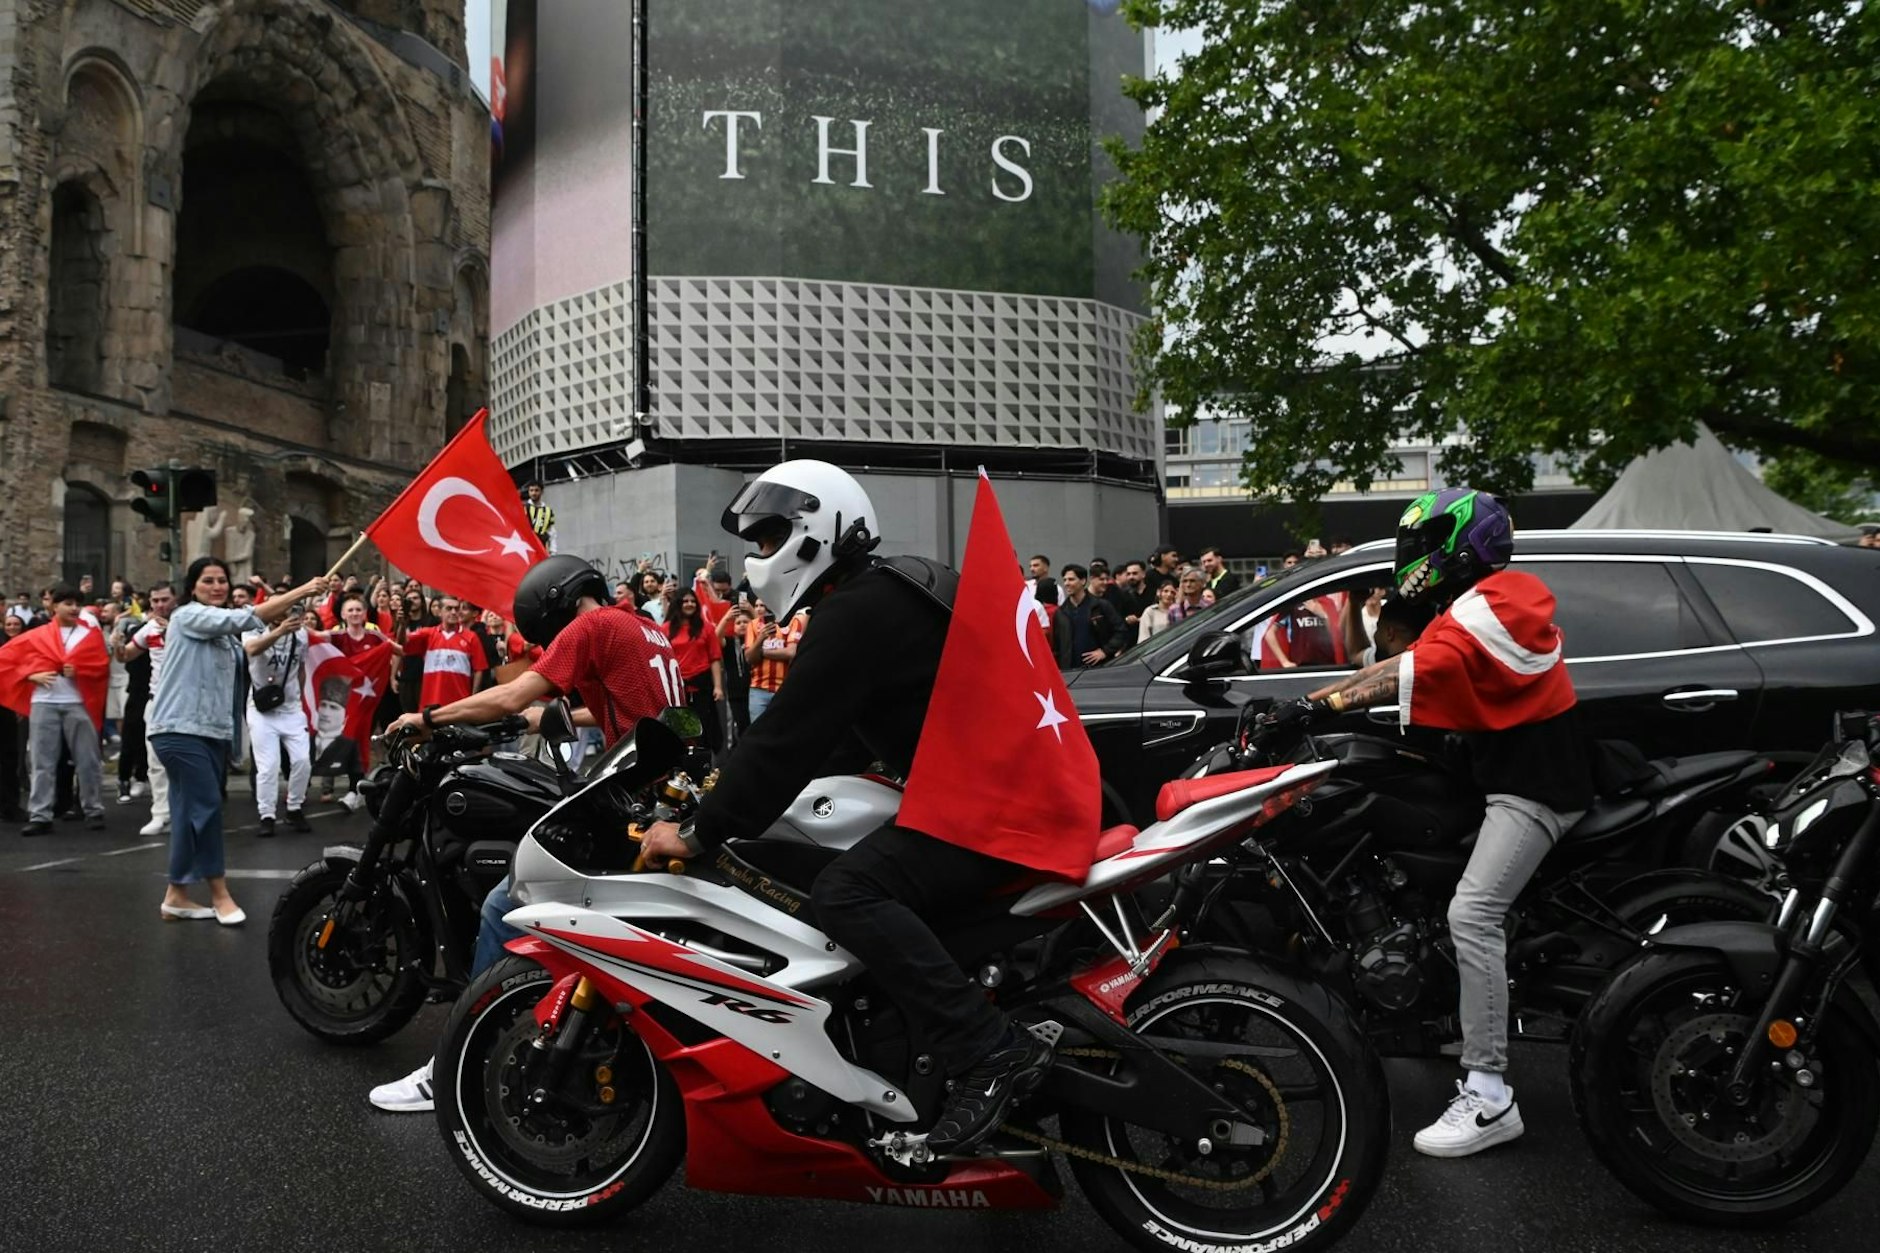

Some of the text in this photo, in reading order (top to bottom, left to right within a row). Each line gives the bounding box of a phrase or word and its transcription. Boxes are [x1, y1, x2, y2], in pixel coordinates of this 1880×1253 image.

[703, 110, 1033, 202] THIS
[649, 654, 685, 708] 10
[753, 876, 801, 914] Racing
[1108, 970, 1138, 990] YAMAH
[698, 993, 795, 1024] R6
[1126, 983, 1286, 1029] ERFORMANCE
[452, 1129, 589, 1212] PERFORMANCE
[865, 1185, 991, 1208] YAMAHA
